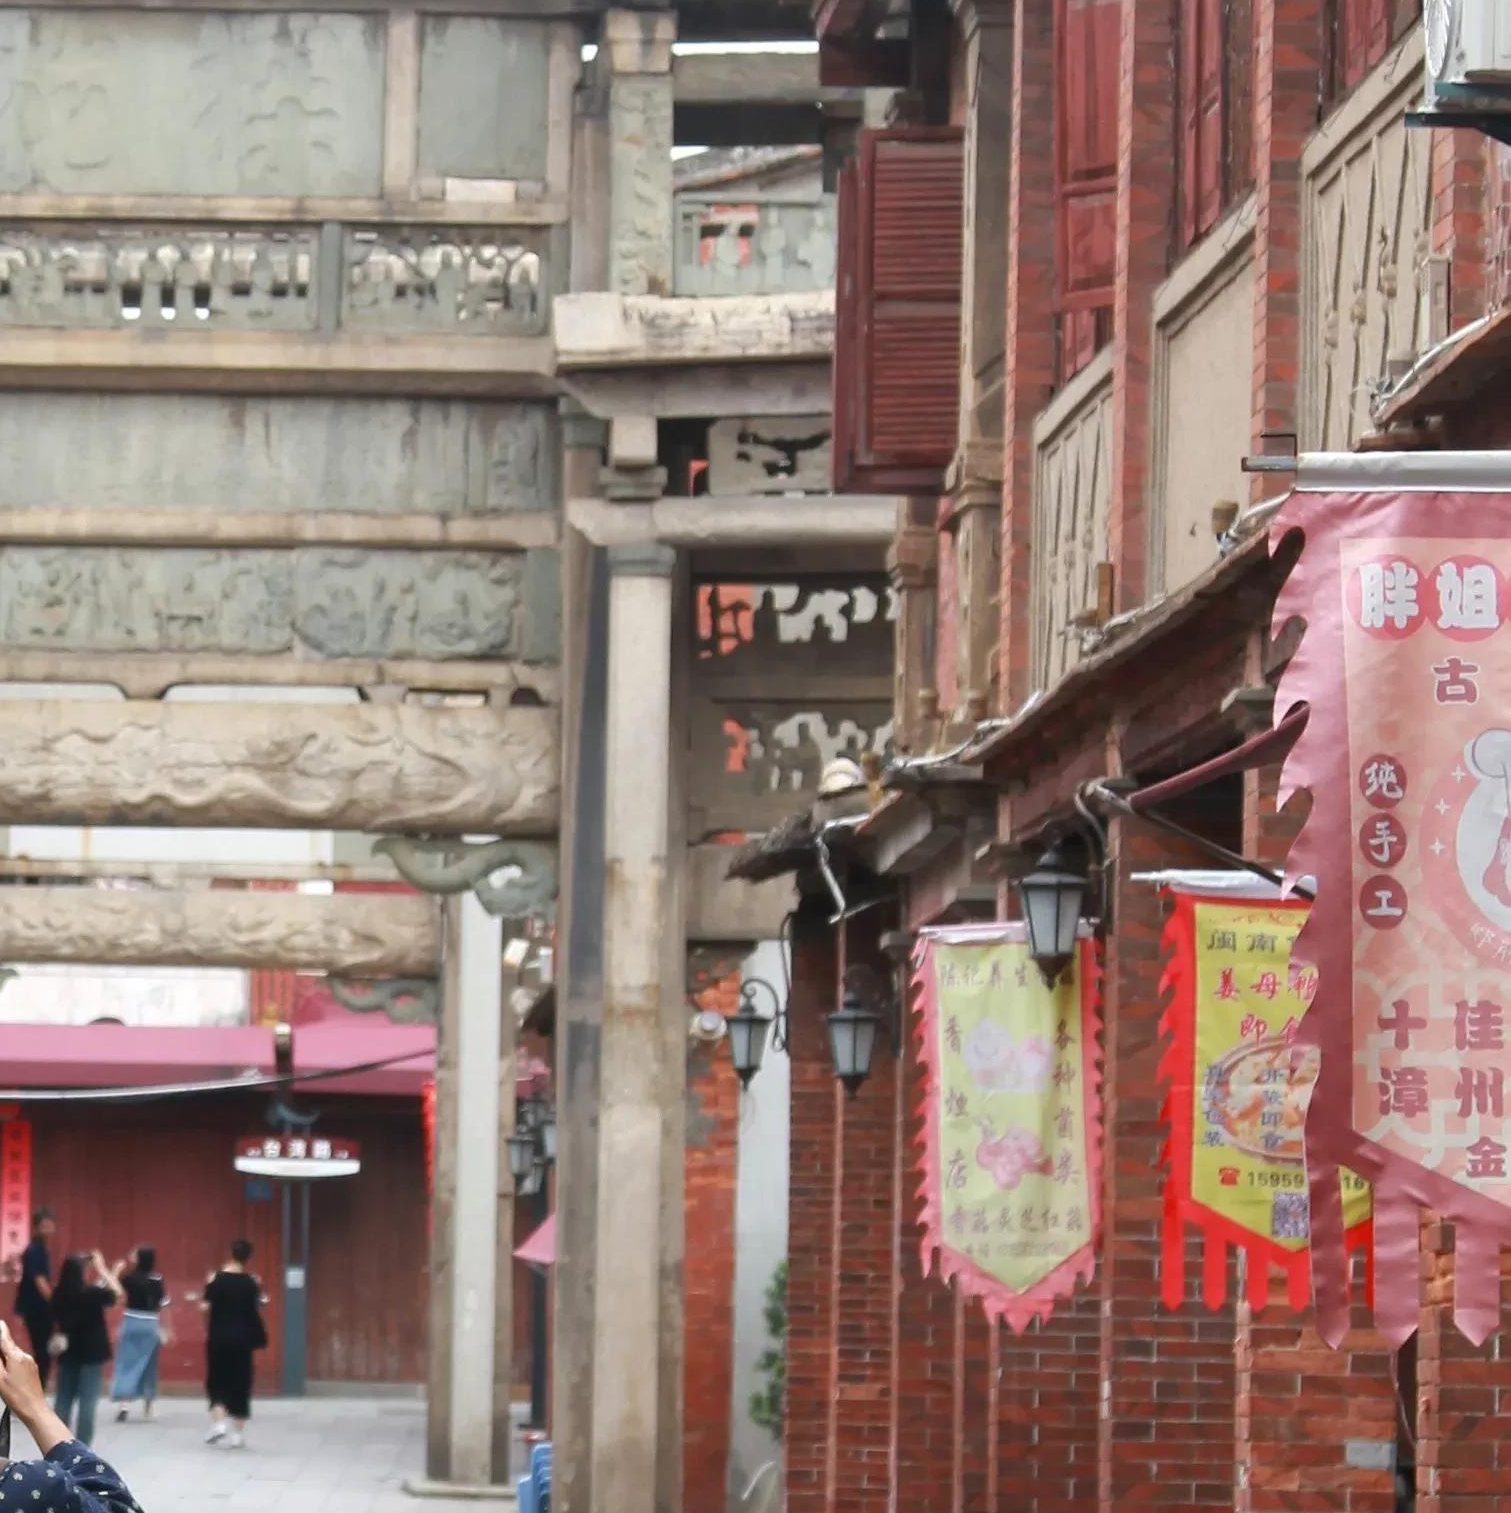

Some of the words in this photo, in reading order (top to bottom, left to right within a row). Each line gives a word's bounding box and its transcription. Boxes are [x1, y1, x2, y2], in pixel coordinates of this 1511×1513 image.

[1360, 562, 1499, 628] 胖姐
[1433, 657, 1479, 703] 古
[1365, 761, 1403, 916] 纯手工
[1206, 930, 1296, 953] 闽南
[1378, 999, 1505, 1051] 十佳
[1378, 1067, 1505, 1118] 漳州
[1466, 1137, 1507, 1178] 金
